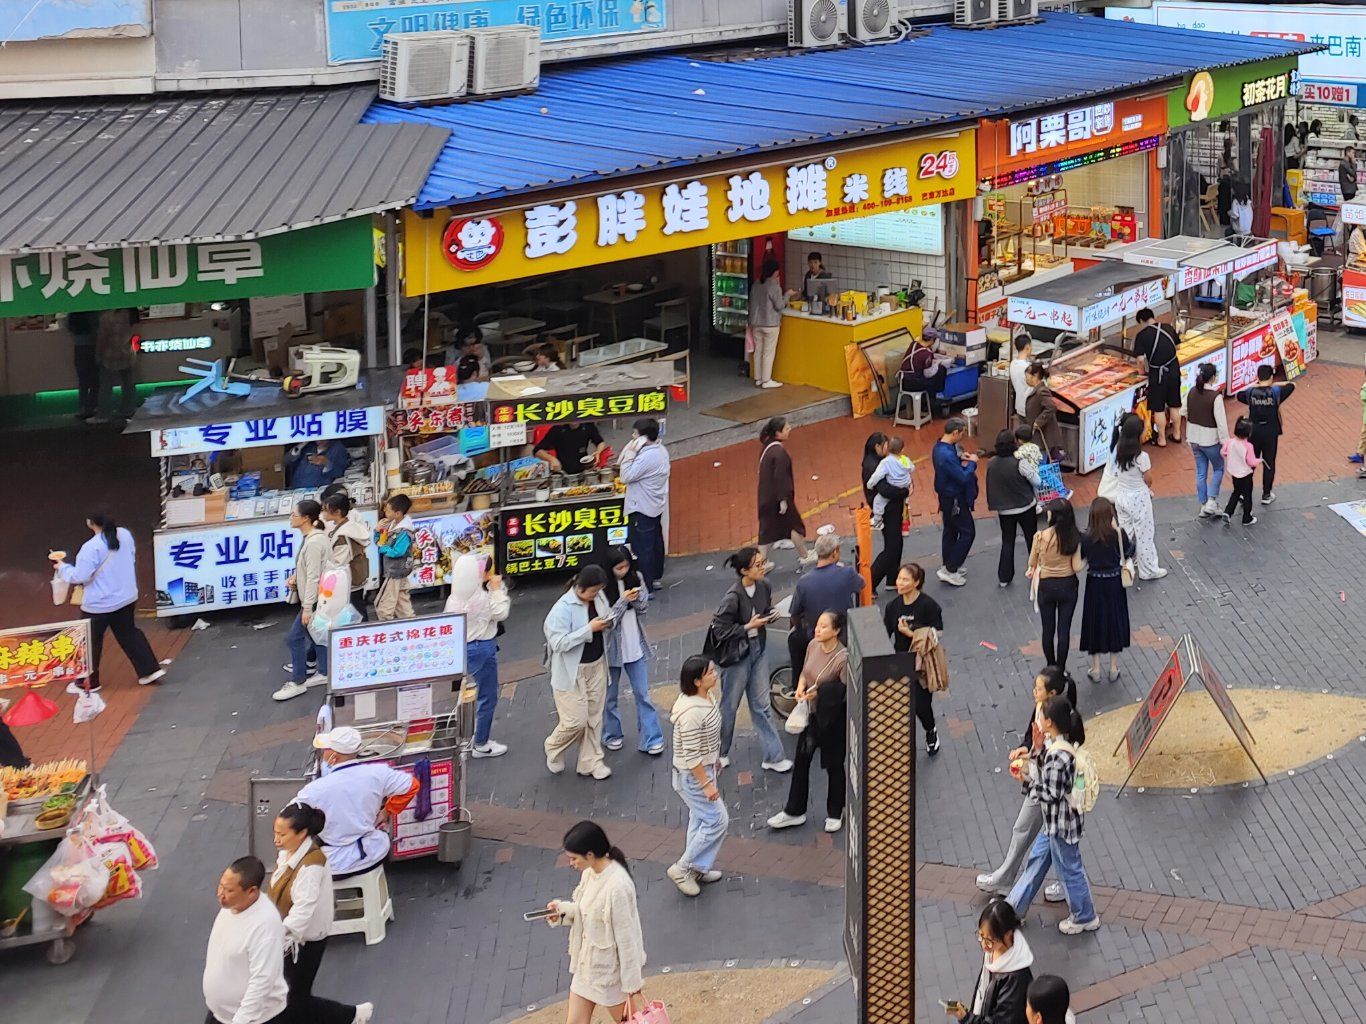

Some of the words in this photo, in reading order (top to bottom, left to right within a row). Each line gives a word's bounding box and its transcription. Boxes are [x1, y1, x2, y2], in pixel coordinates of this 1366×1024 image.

[368, 9, 488, 52] 文明健康
[1242, 75, 1287, 107] 初茶花月
[1303, 83, 1351, 102] 买10赠1
[1009, 108, 1091, 156] 阿栗哥
[524, 163, 828, 260] 彭胖娃地摊
[843, 167, 909, 205] 米线
[1013, 305, 1073, 327] 一元一串起
[407, 406, 465, 431] 关东煮
[514, 391, 667, 423] 长沙臭豆腐
[199, 408, 368, 446] 专业贴膜
[523, 505, 629, 536] 长沙臭豆
[505, 554, 579, 575] 锅巴土豆7元
[338, 624, 454, 649] 重庆花式棉花糖
